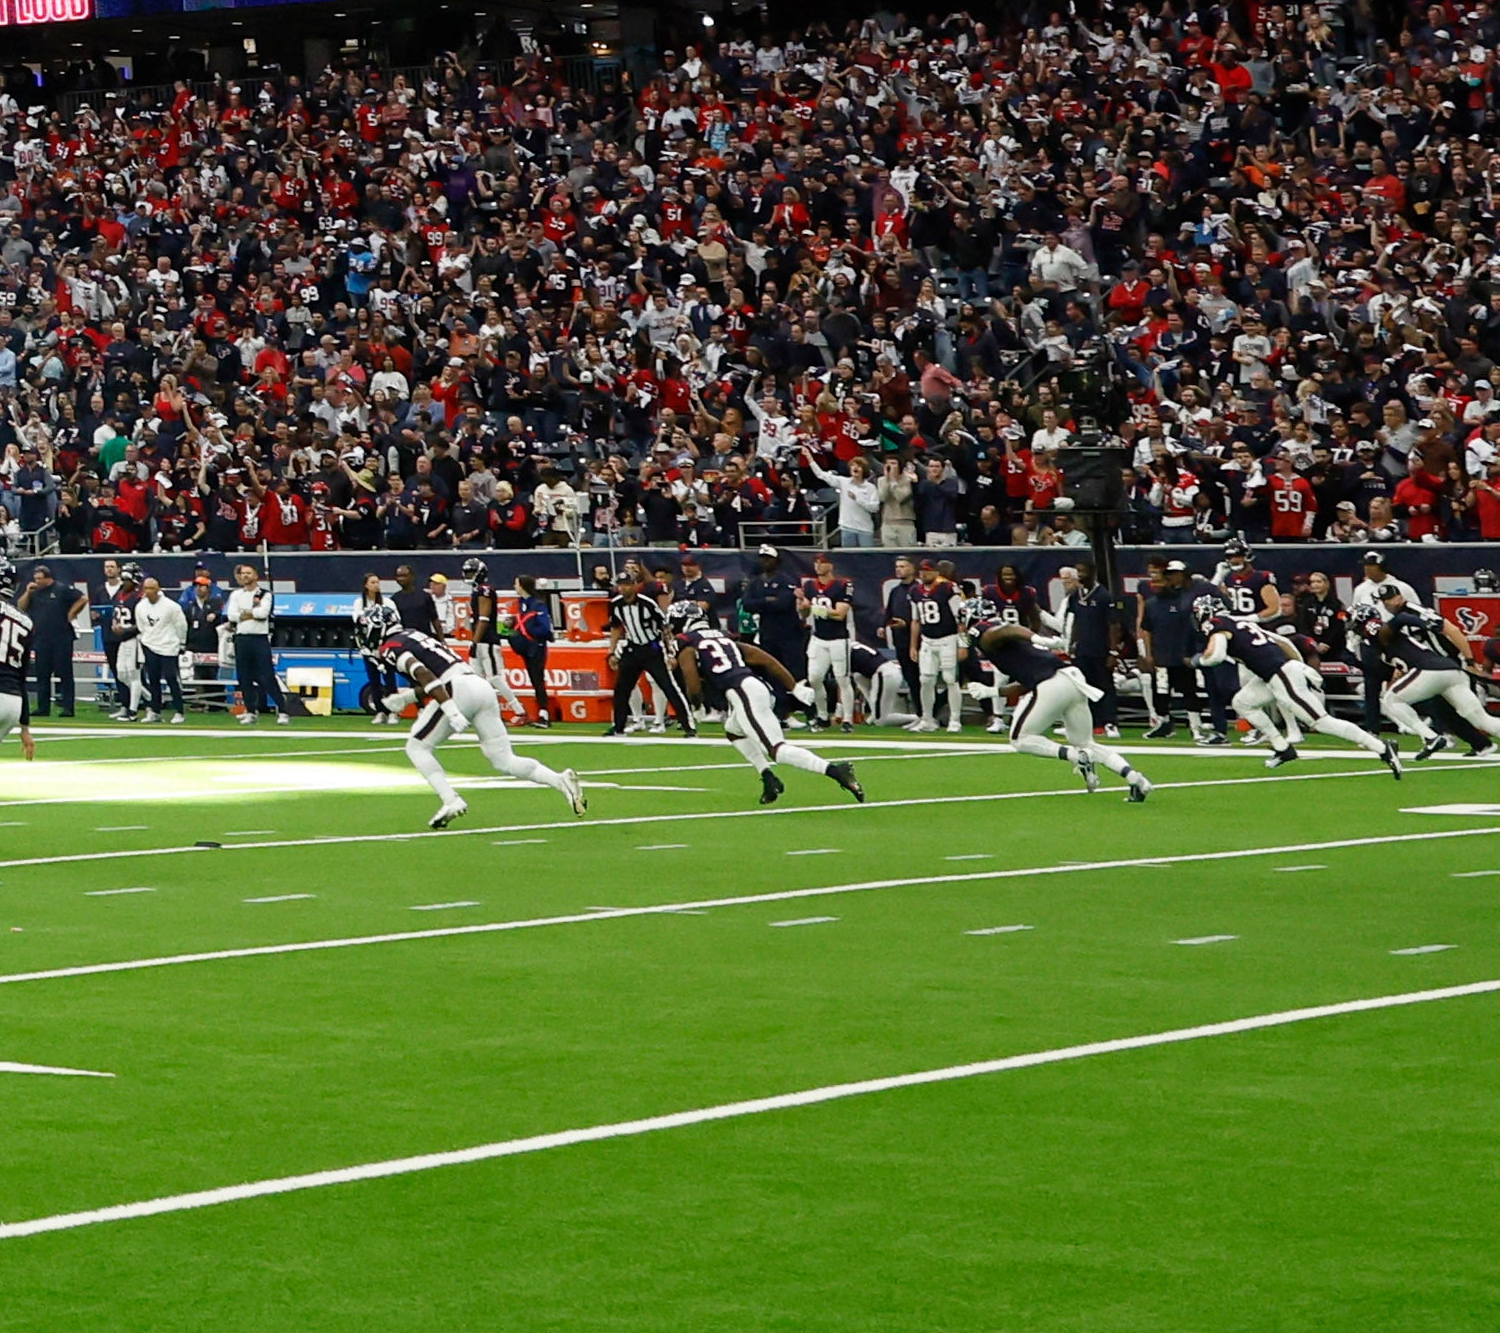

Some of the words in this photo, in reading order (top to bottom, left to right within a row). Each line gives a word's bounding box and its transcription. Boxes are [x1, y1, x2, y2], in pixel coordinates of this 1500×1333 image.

[1275, 492, 1302, 513] 59
[455, 604, 466, 619] G
[567, 604, 582, 620] G
[917, 600, 940, 625] 18
[698, 637, 745, 673] 37
[571, 701, 587, 719] G
